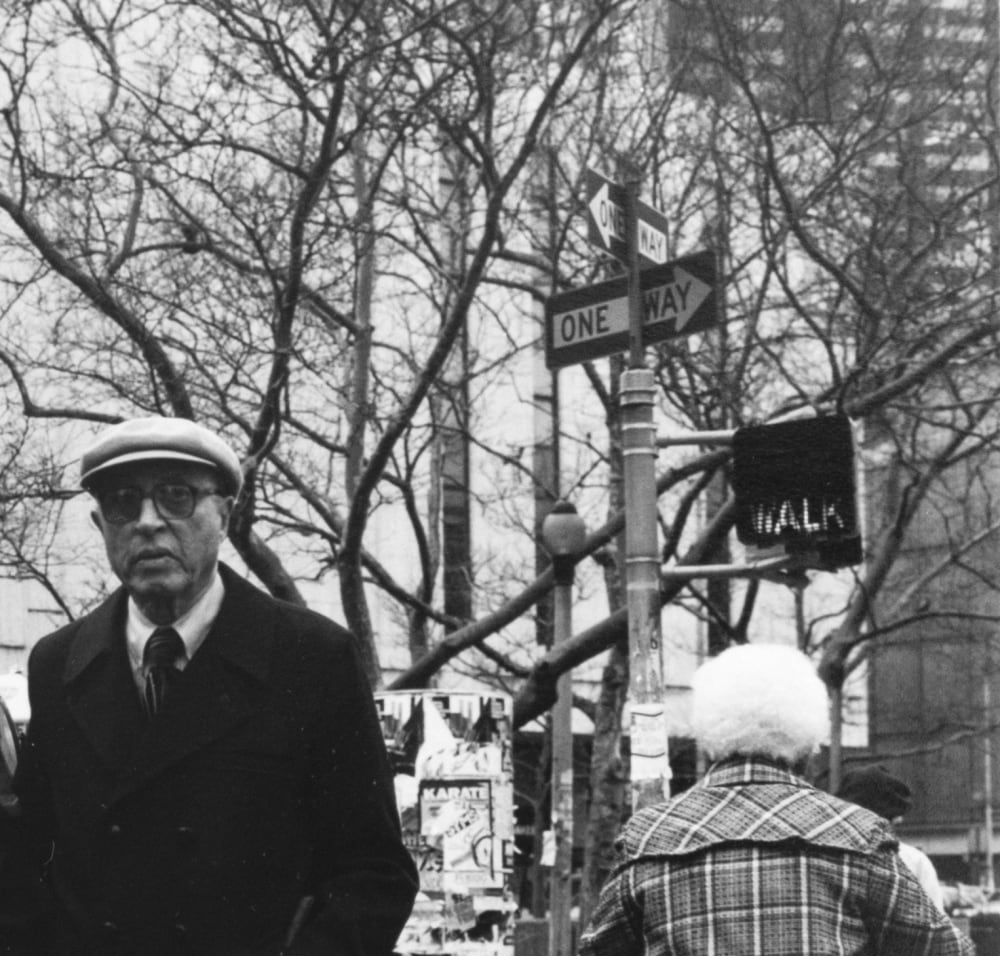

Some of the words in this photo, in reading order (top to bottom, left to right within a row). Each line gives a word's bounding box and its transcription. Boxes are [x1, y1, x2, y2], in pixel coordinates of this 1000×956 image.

[640, 229, 663, 261] WAY
[560, 305, 610, 343] ONE
[642, 279, 692, 322] WAY
[751, 497, 845, 535] WALK
[423, 787, 488, 800] KARATE
